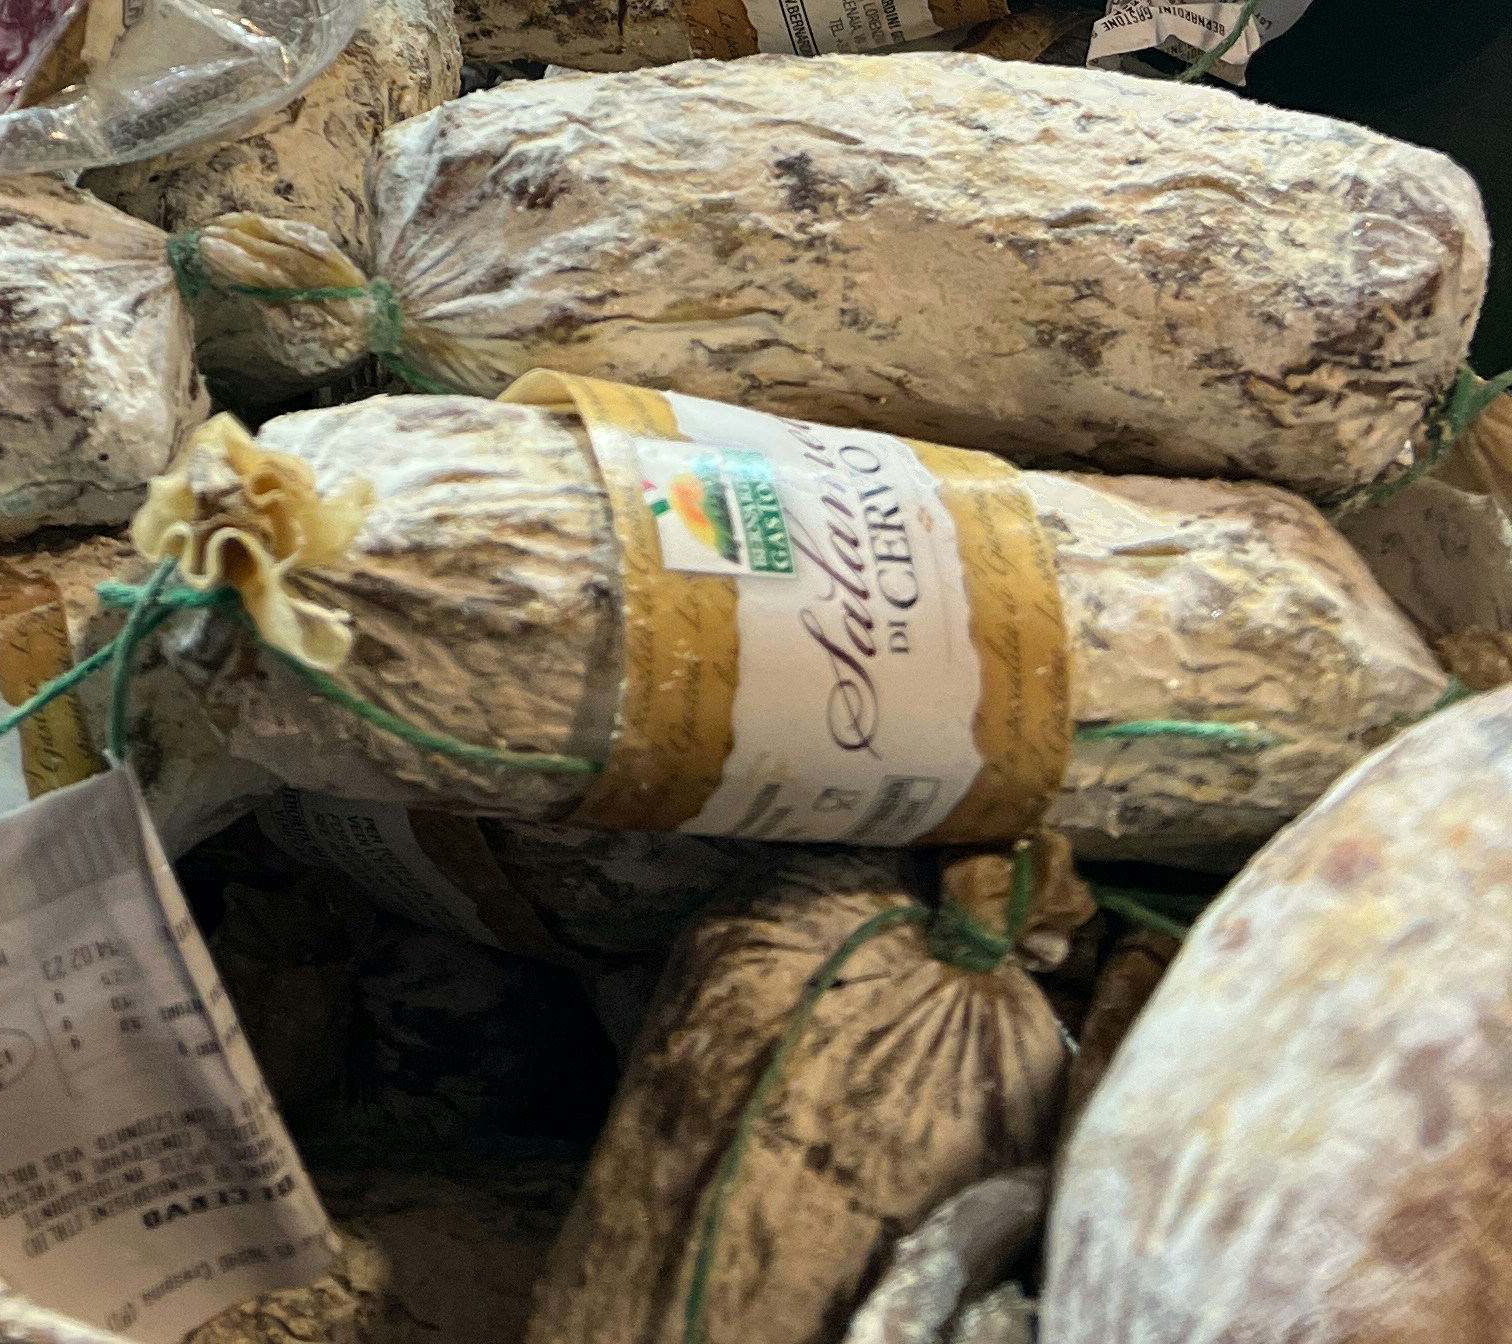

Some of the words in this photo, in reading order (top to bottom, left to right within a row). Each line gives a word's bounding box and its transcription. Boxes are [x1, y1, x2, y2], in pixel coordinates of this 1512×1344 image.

[1103, 7, 1153, 31] GASTONE
[1158, 6, 1225, 36] BERNARDINI
[839, 445, 920, 611] CERVO
[889, 620, 910, 655] DI
